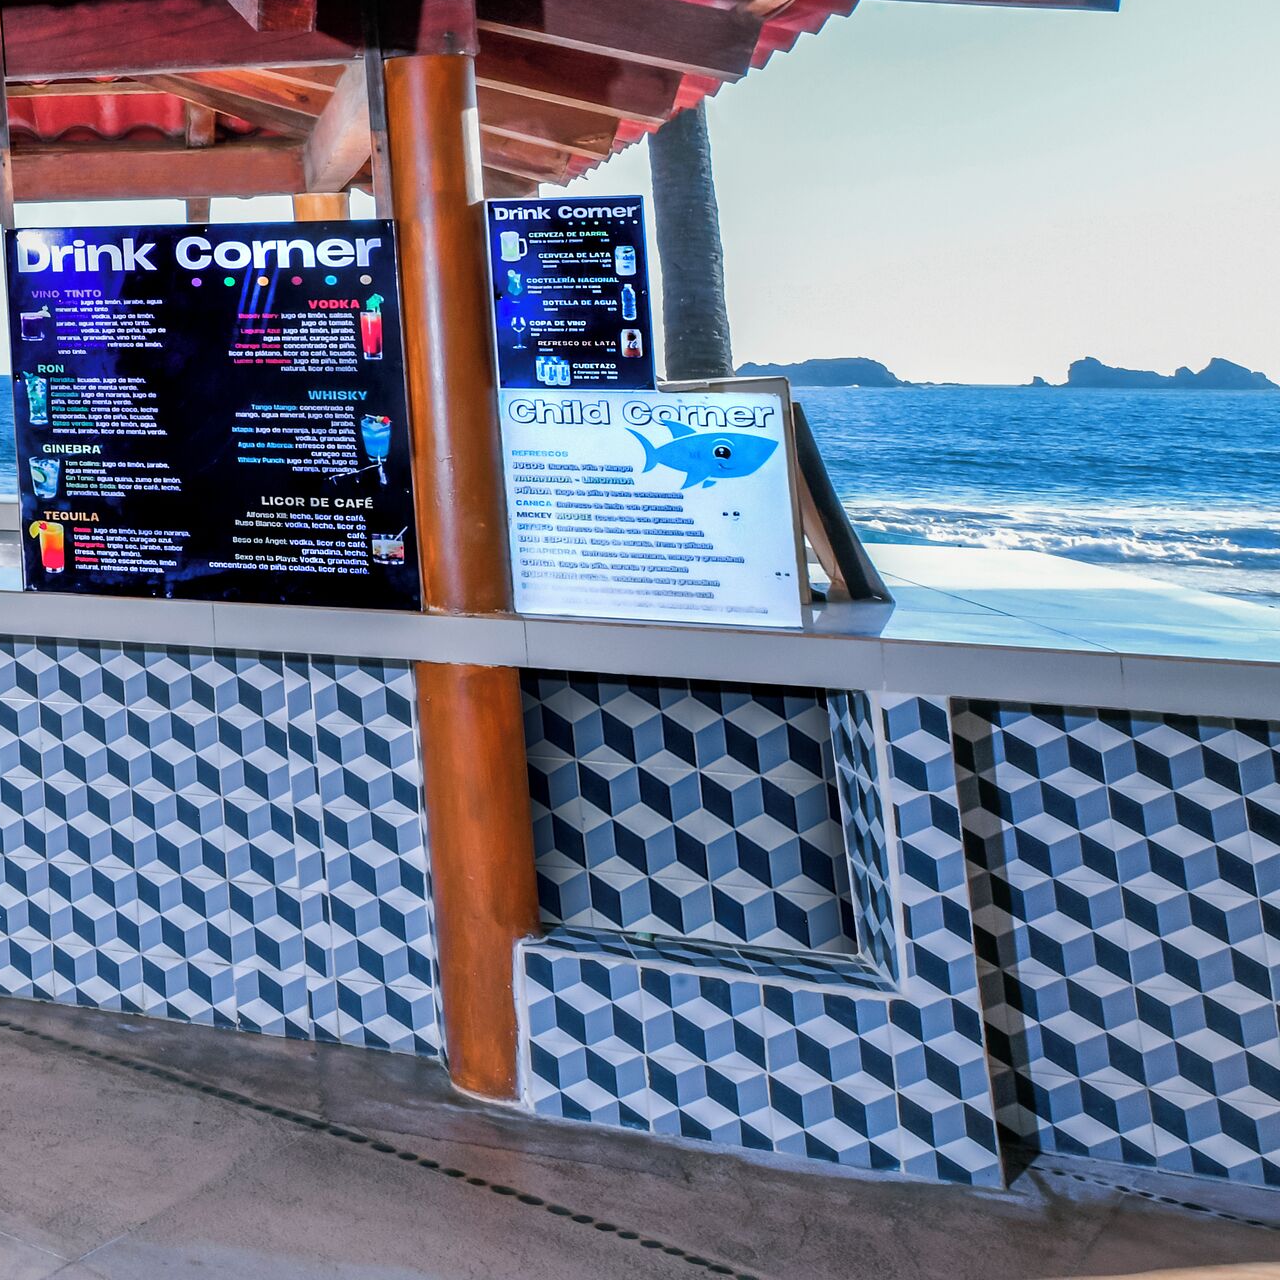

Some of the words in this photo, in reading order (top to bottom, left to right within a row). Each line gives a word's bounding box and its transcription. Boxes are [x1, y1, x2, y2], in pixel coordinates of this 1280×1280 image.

[494, 206, 551, 220] Drink
[558, 206, 636, 218] Corner
[18, 237, 157, 273] Drink
[176, 236, 382, 270] Corner
[64, 290, 102, 298] TINTO
[308, 300, 360, 309] VODKA
[38, 364, 64, 373] RON
[308, 390, 368, 400] WHISKY
[508, 400, 610, 425] Child
[623, 400, 775, 428] Corner
[43, 444, 101, 454] GINEBRA
[512, 450, 568, 458] REFRESCOS
[261, 496, 304, 506] LICOR
[310, 498, 330, 508] DE
[334, 497, 374, 508] CAFÉ
[44, 511, 100, 521] TEQUILA
[517, 512, 552, 520] MICKEY
